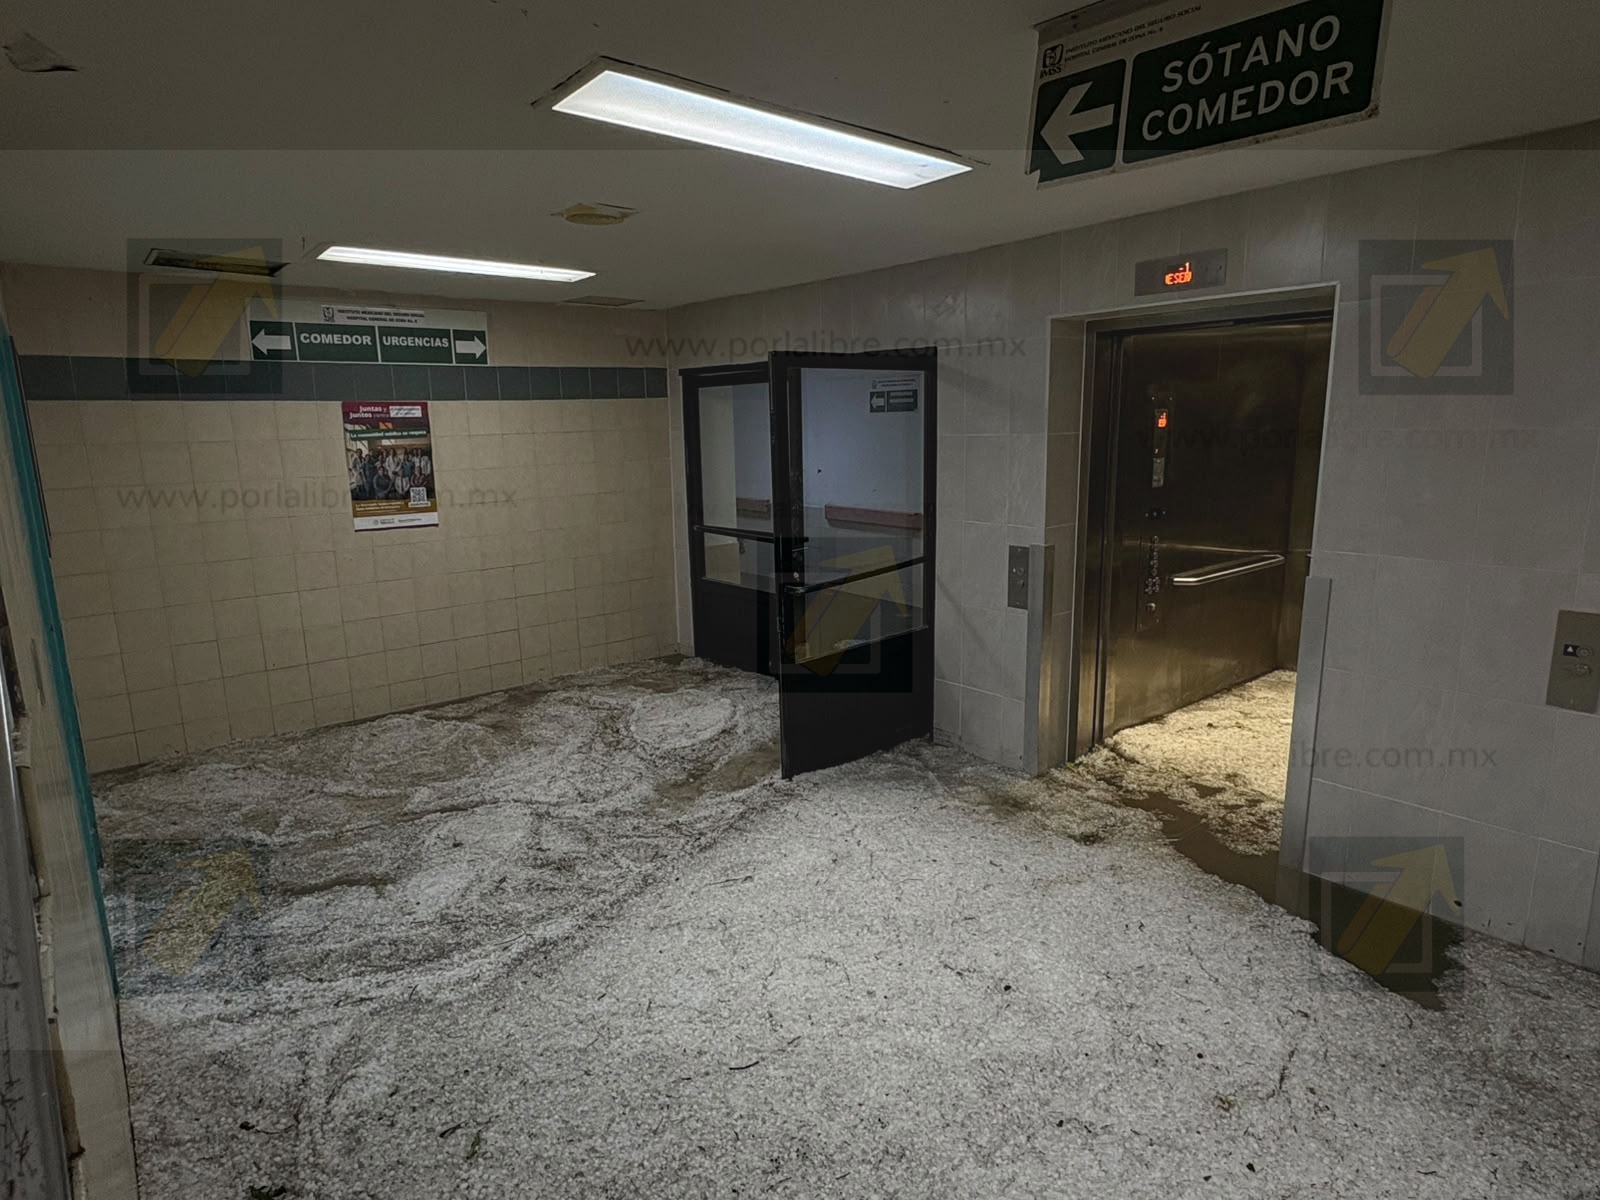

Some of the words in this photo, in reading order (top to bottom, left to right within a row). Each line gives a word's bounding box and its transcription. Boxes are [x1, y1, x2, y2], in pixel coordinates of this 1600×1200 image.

[1040, 64, 1062, 79] IMSS
[1162, 15, 1341, 93] SÓTANO
[1142, 61, 1354, 141] COMEDOR
[300, 332, 372, 345] COMEDOR
[382, 335, 449, 347] URGENCIAS
